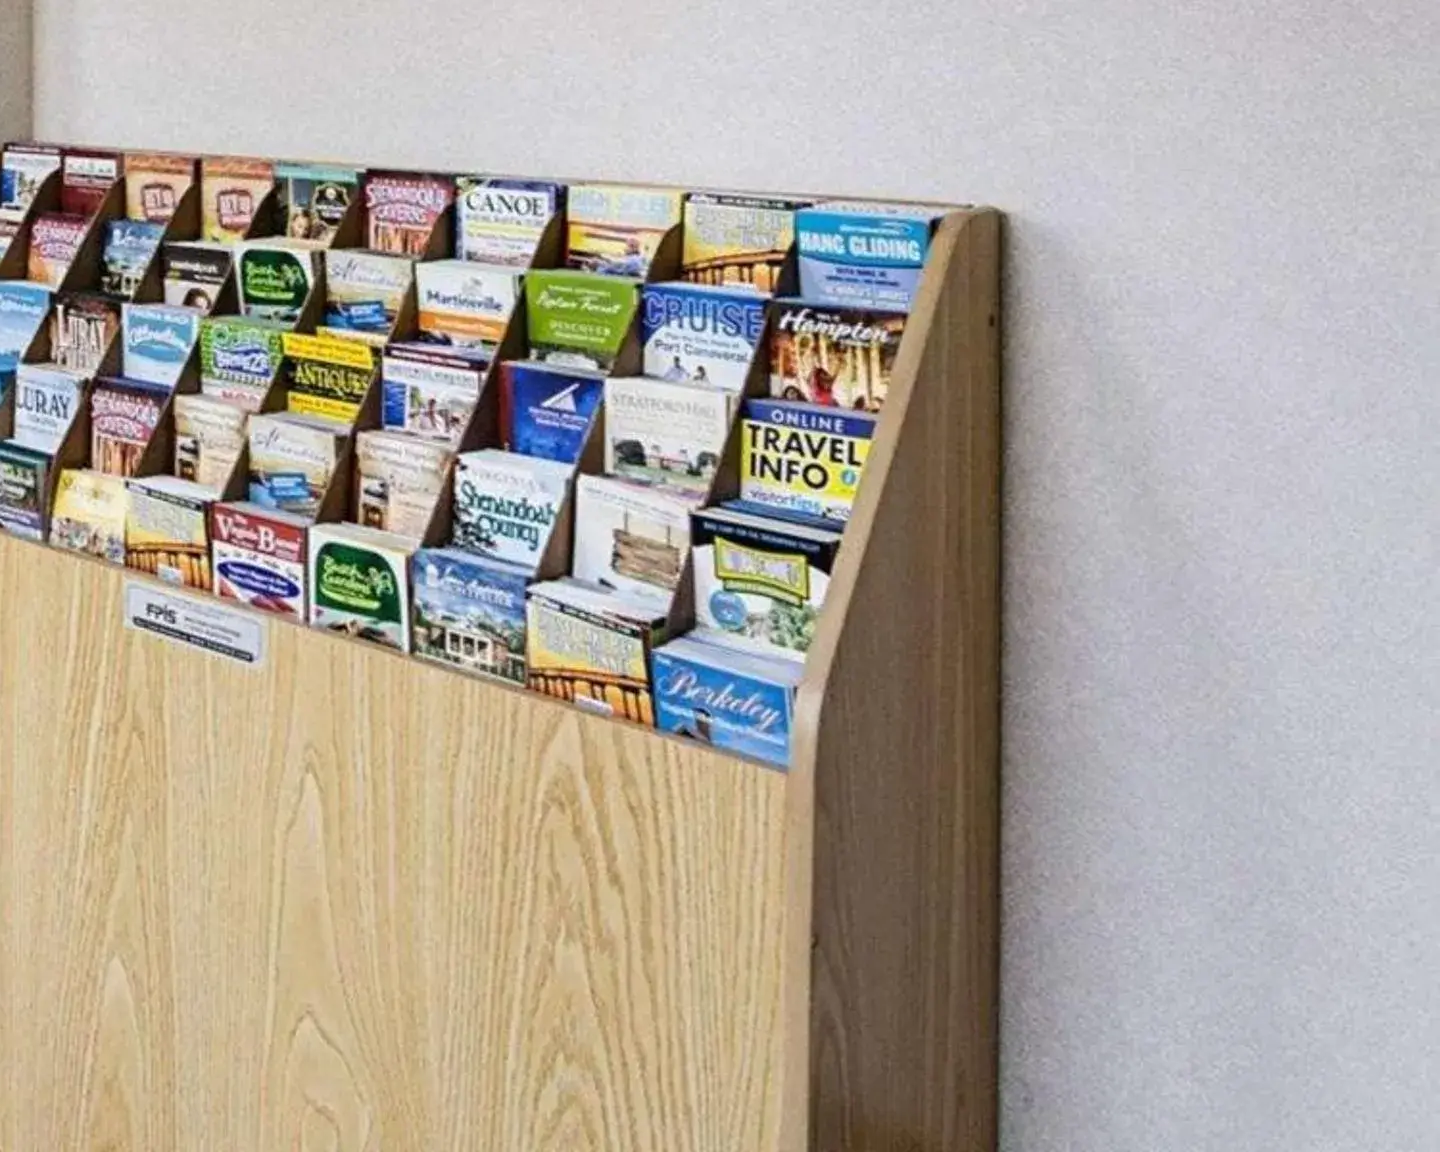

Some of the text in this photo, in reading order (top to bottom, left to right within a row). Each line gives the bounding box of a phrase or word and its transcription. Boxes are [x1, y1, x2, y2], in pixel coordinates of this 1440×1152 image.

[465, 191, 545, 217] CANOE
[799, 230, 921, 262] HANG GLIDING
[644, 292, 765, 343] CRUISE
[778, 308, 889, 343] Hampton
[294, 363, 369, 396] ANTIQUES
[771, 408, 845, 433] ONLINE
[747, 423, 862, 467] TRAVEL
[749, 452, 829, 490] INFO
[661, 666, 783, 732] Berkeley
